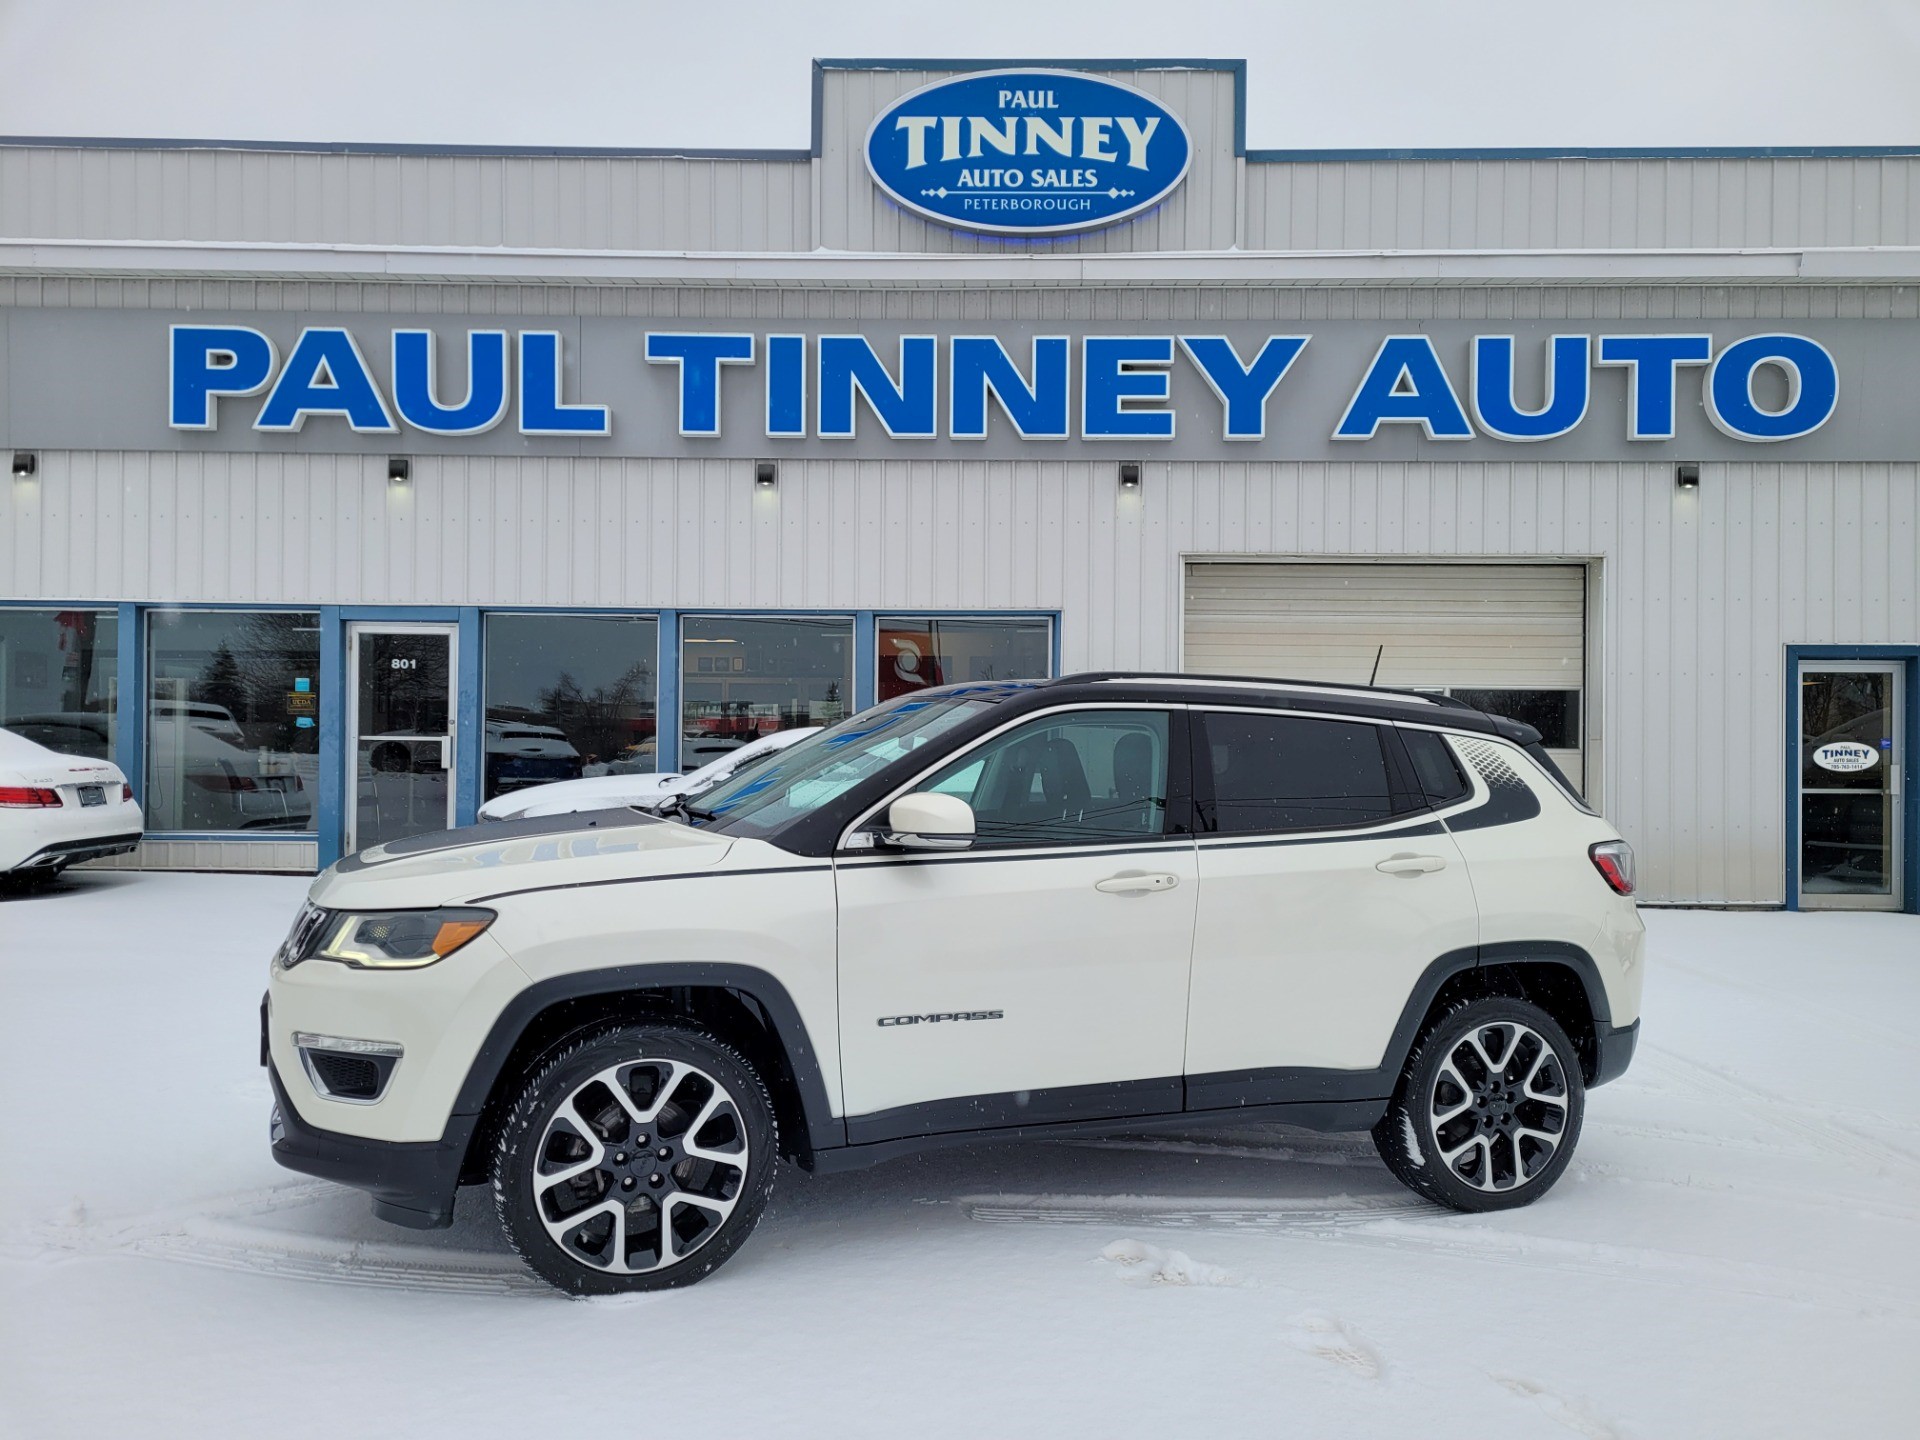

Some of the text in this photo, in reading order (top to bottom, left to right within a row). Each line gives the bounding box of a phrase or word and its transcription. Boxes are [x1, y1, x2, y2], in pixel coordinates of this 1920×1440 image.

[998, 90, 1059, 109] PAUL
[895, 116, 1161, 172] TINNEY
[957, 169, 1098, 188] AUTO SALES
[964, 198, 1091, 211] PETERBOROUGH
[168, 323, 1840, 443] PAUL TINNEY AUTO
[391, 658, 416, 669] 801
[1822, 749, 1870, 760] TINNEY
[877, 1009, 1004, 1027] COMPASS
